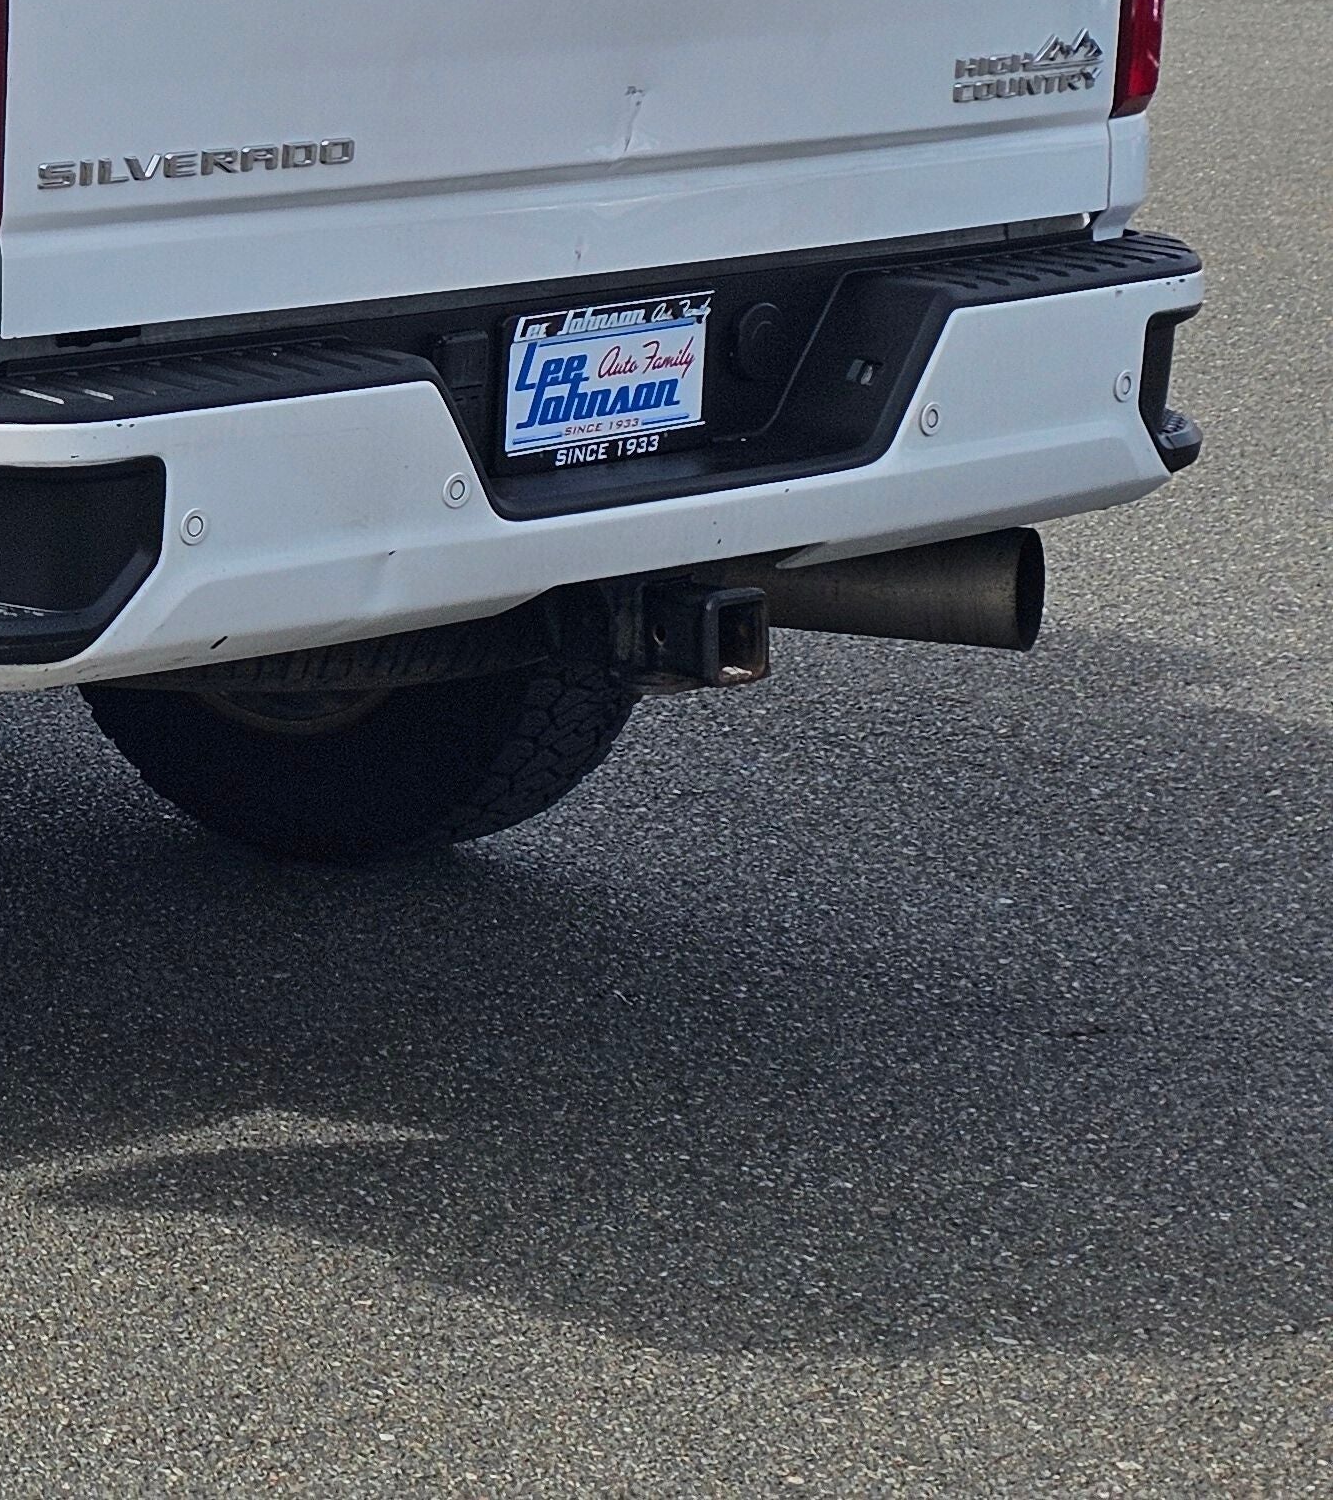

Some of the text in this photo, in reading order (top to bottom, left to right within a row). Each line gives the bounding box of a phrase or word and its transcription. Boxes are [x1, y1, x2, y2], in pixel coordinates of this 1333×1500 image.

[954, 51, 1036, 79] HIGH
[952, 67, 1103, 104] COUNTRY
[37, 137, 356, 190] SILVERADO
[557, 306, 648, 336] Johnson
[514, 336, 696, 392] Lee Auto Family
[515, 376, 681, 430] Johnson
[564, 417, 640, 436] SINCE 1933
[555, 434, 660, 466] SINCE 1933
